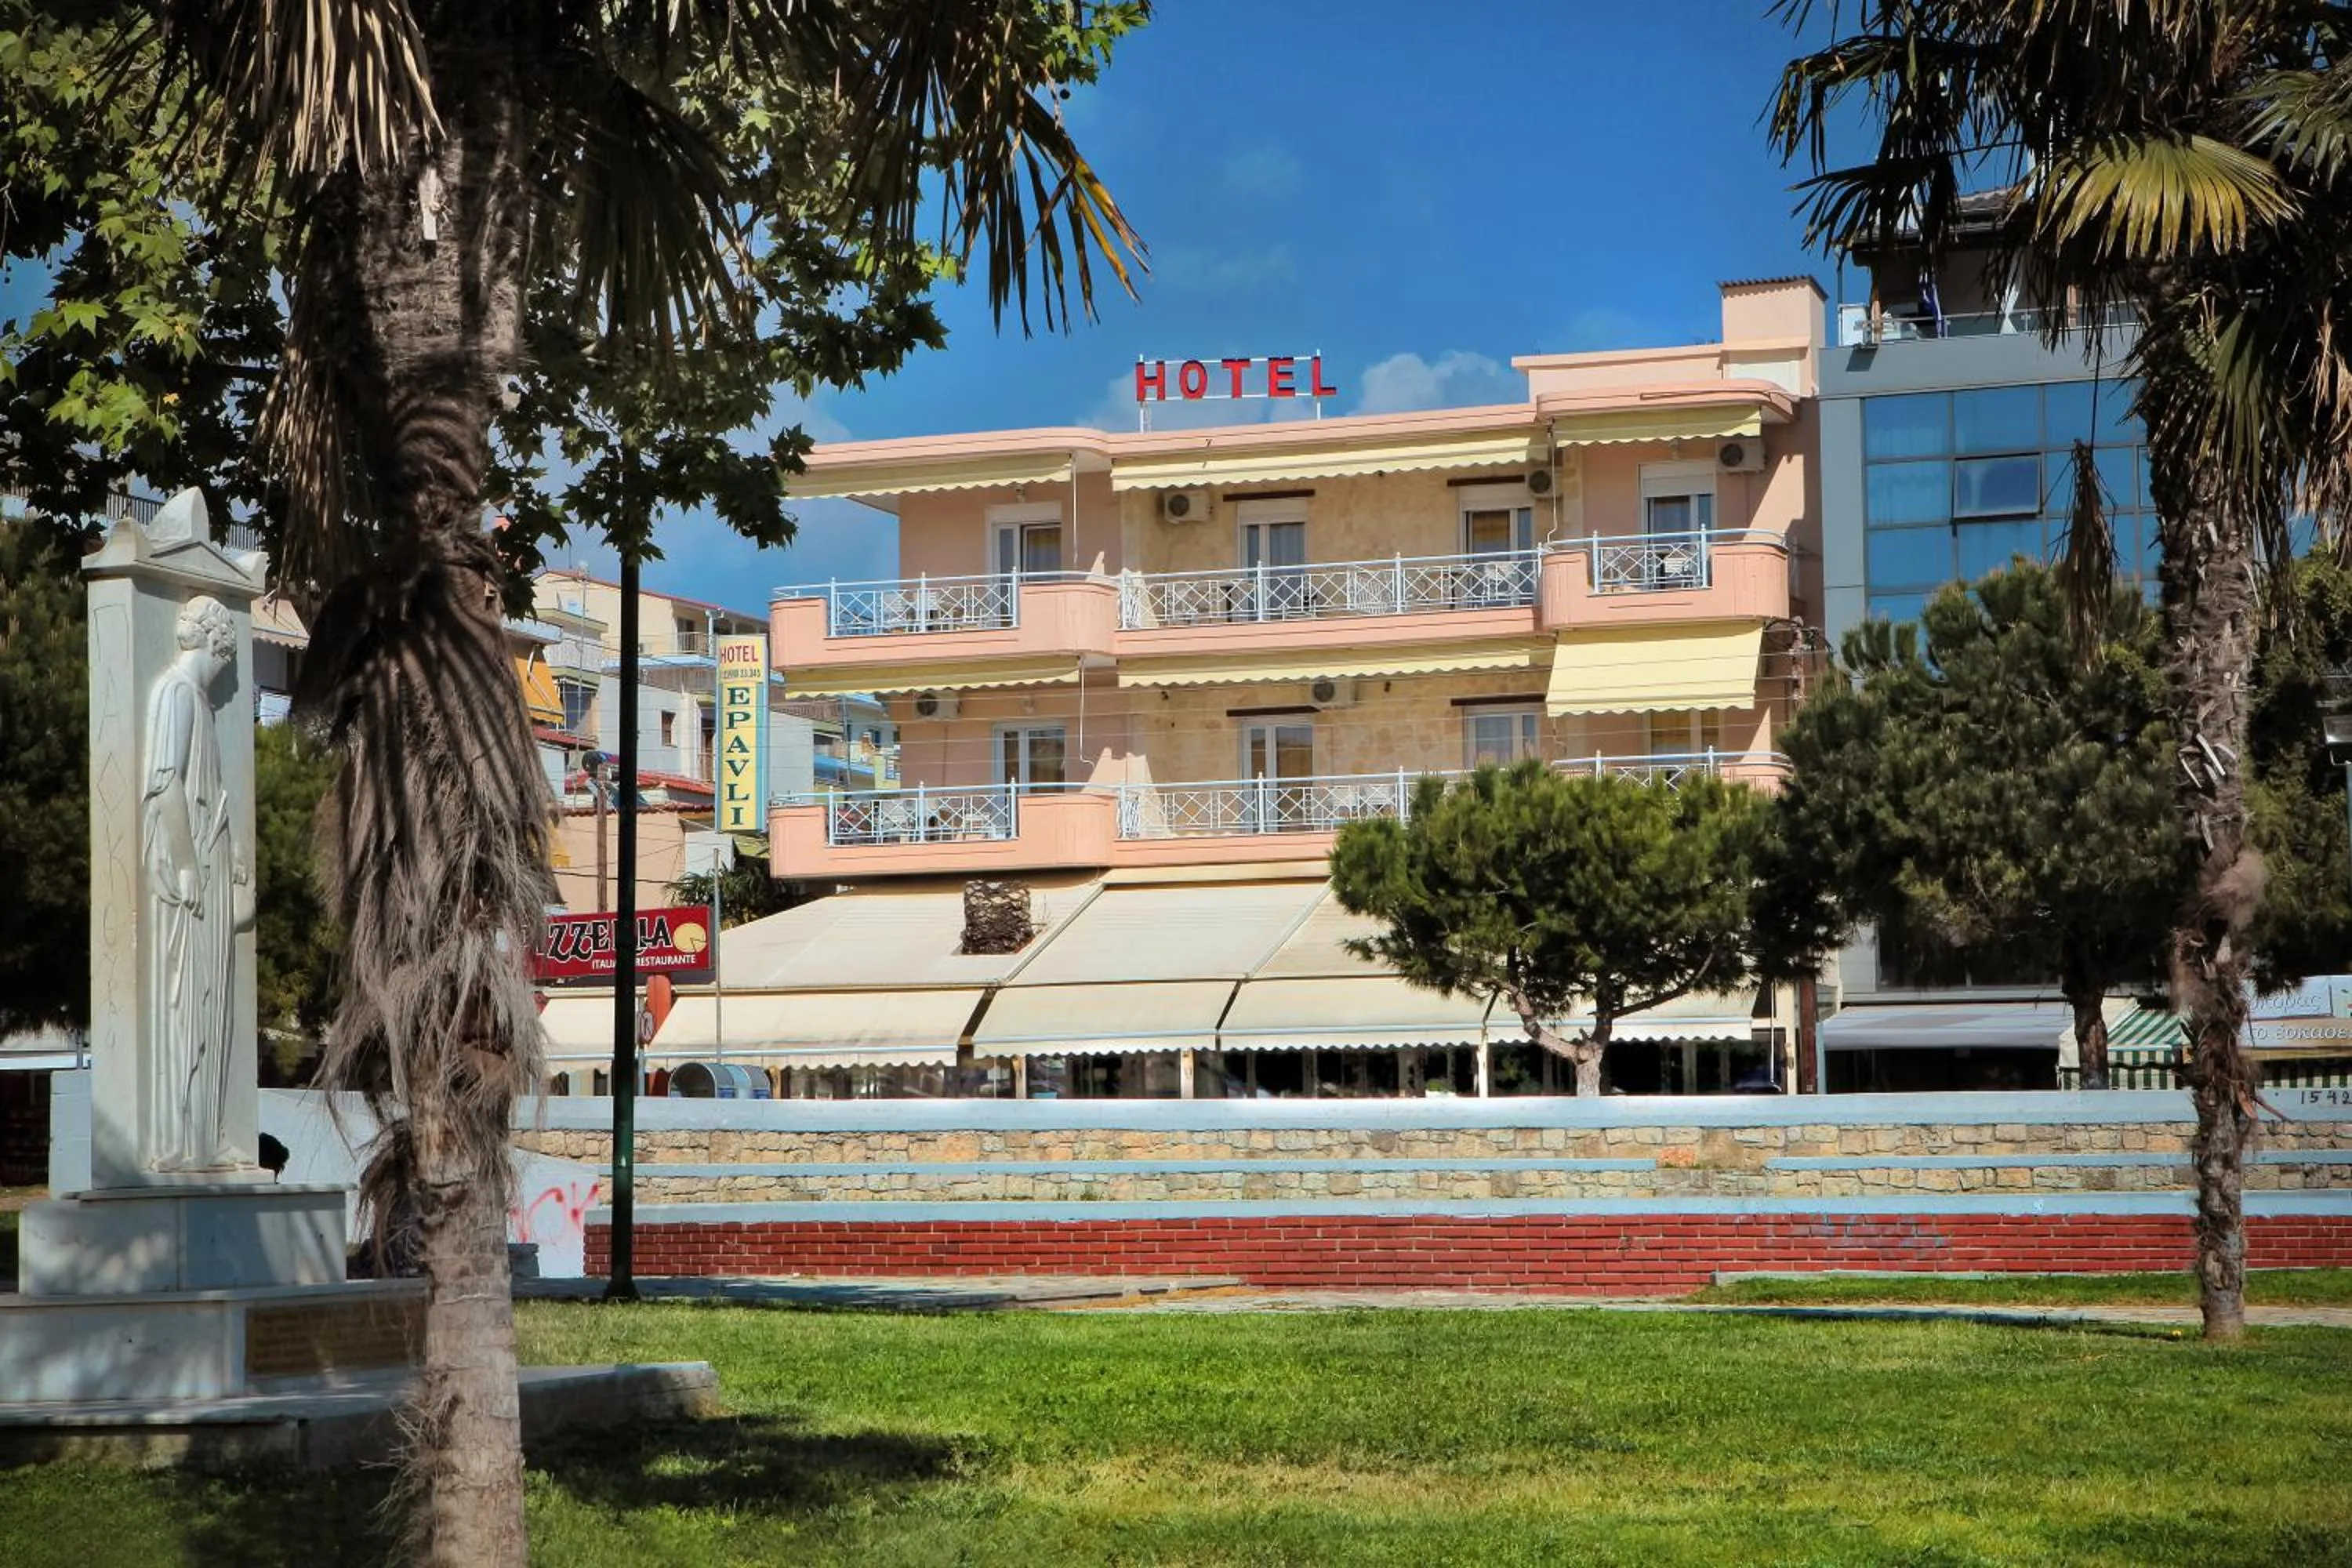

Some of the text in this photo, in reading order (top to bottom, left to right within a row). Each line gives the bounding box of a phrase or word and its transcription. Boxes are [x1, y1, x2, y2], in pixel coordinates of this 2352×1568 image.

[1135, 356, 1337, 401] HOTEL
[719, 645, 759, 664] HOTEL
[726, 687, 751, 826] EPAVLI
[521, 916, 673, 964] ZZEIA
[635, 954, 696, 967] RESTAURANTE
